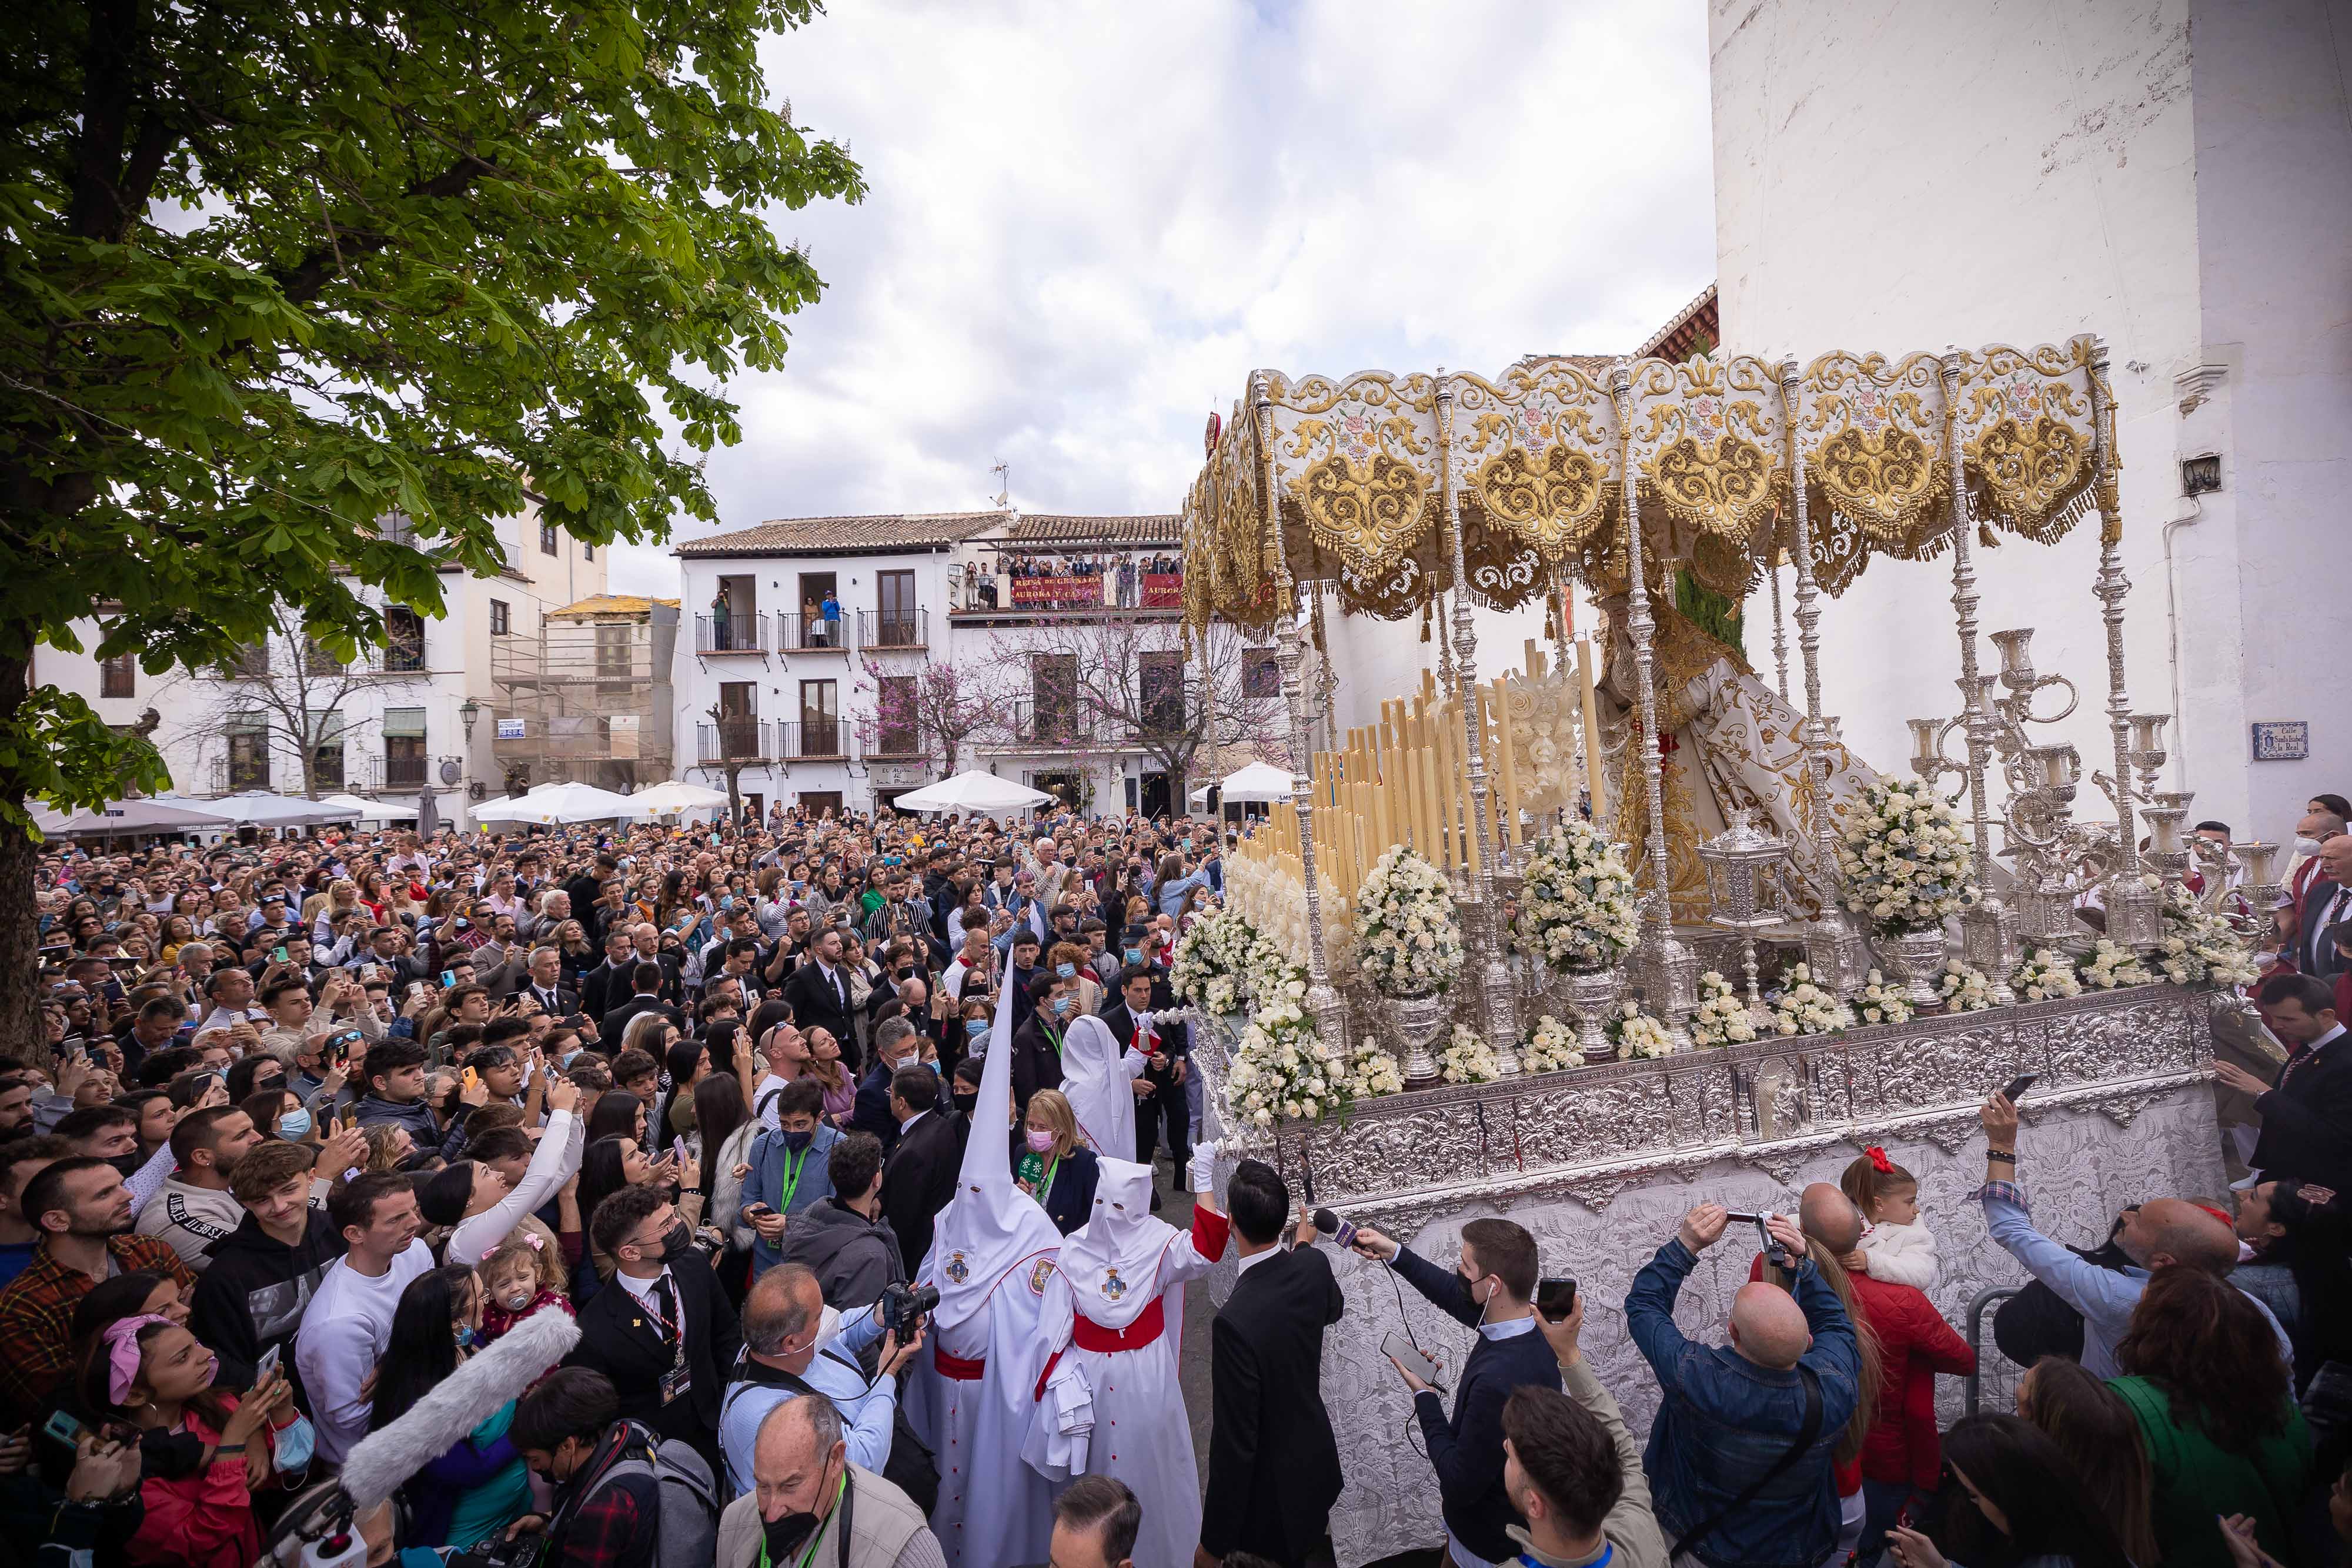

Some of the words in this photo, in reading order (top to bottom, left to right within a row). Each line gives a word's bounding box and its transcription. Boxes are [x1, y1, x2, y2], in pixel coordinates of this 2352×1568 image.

[2286, 743, 2299, 751] Real
[184, 1219, 196, 1228] IT
[192, 1223, 209, 1235] GET
[1340, 1226, 1354, 1246] COFRADE
